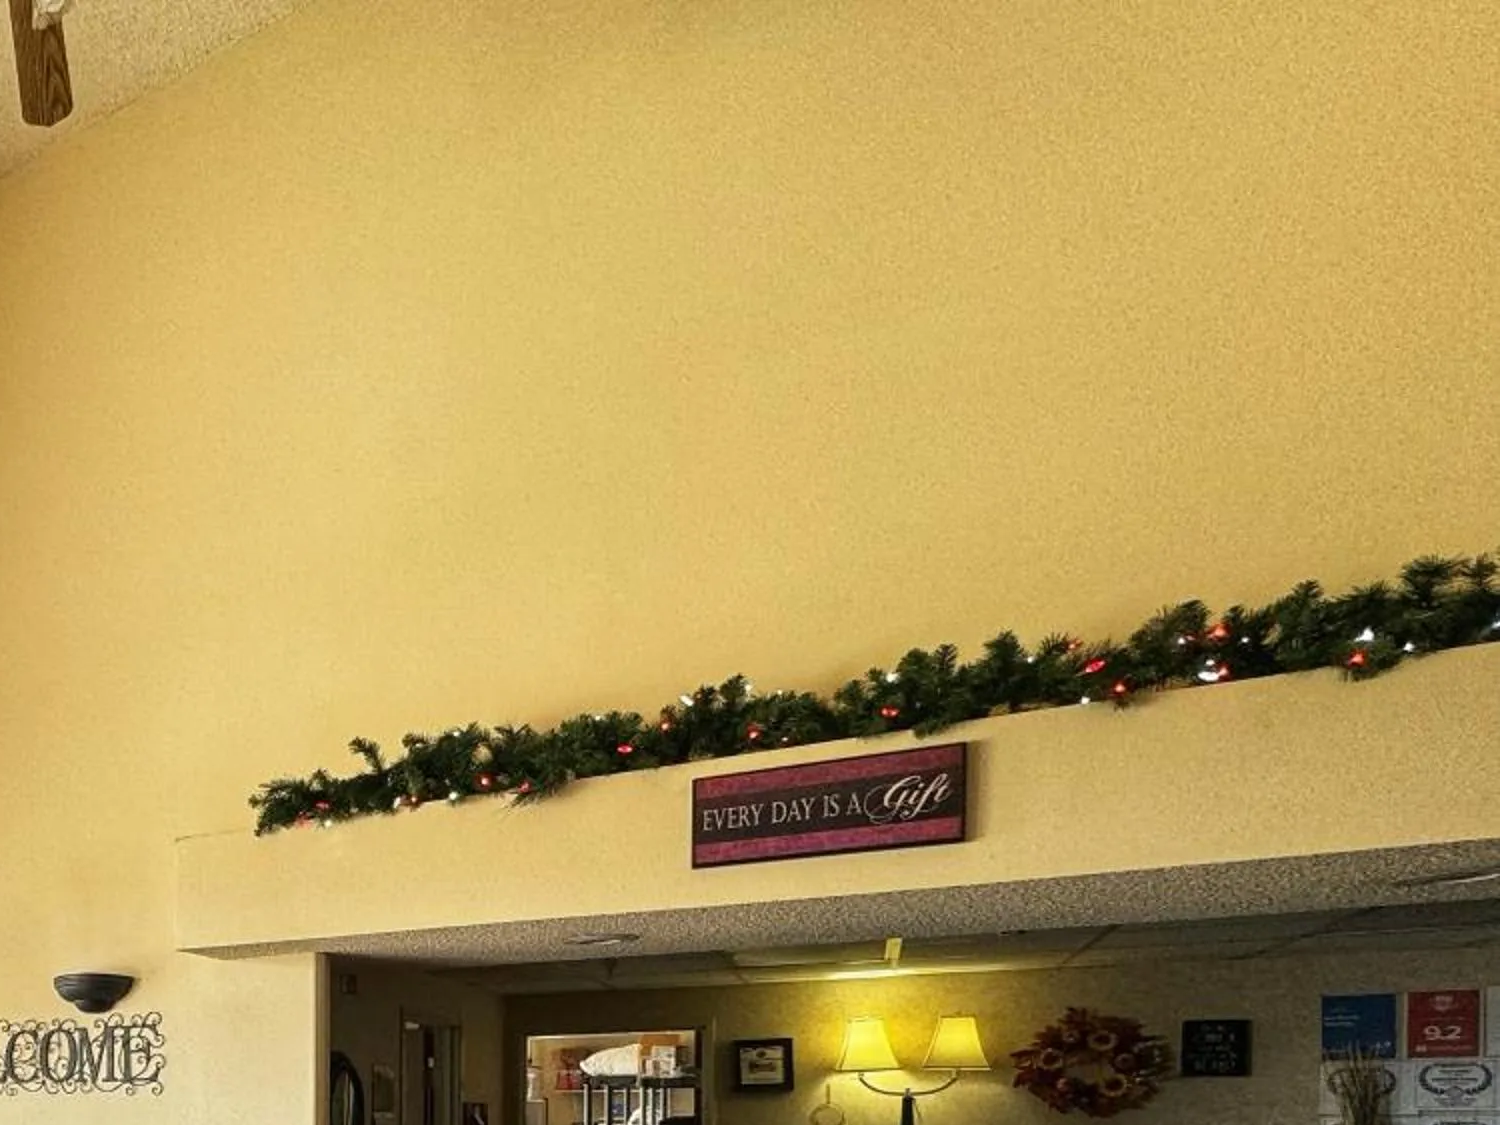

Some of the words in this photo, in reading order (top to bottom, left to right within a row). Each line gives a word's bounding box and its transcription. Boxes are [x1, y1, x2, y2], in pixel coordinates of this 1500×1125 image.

[702, 803, 764, 832] EVERY
[771, 797, 815, 825] DAY
[823, 792, 841, 818] IS
[846, 792, 863, 815] A
[864, 773, 952, 825] Gift
[1421, 1024, 1463, 1042] 9.2
